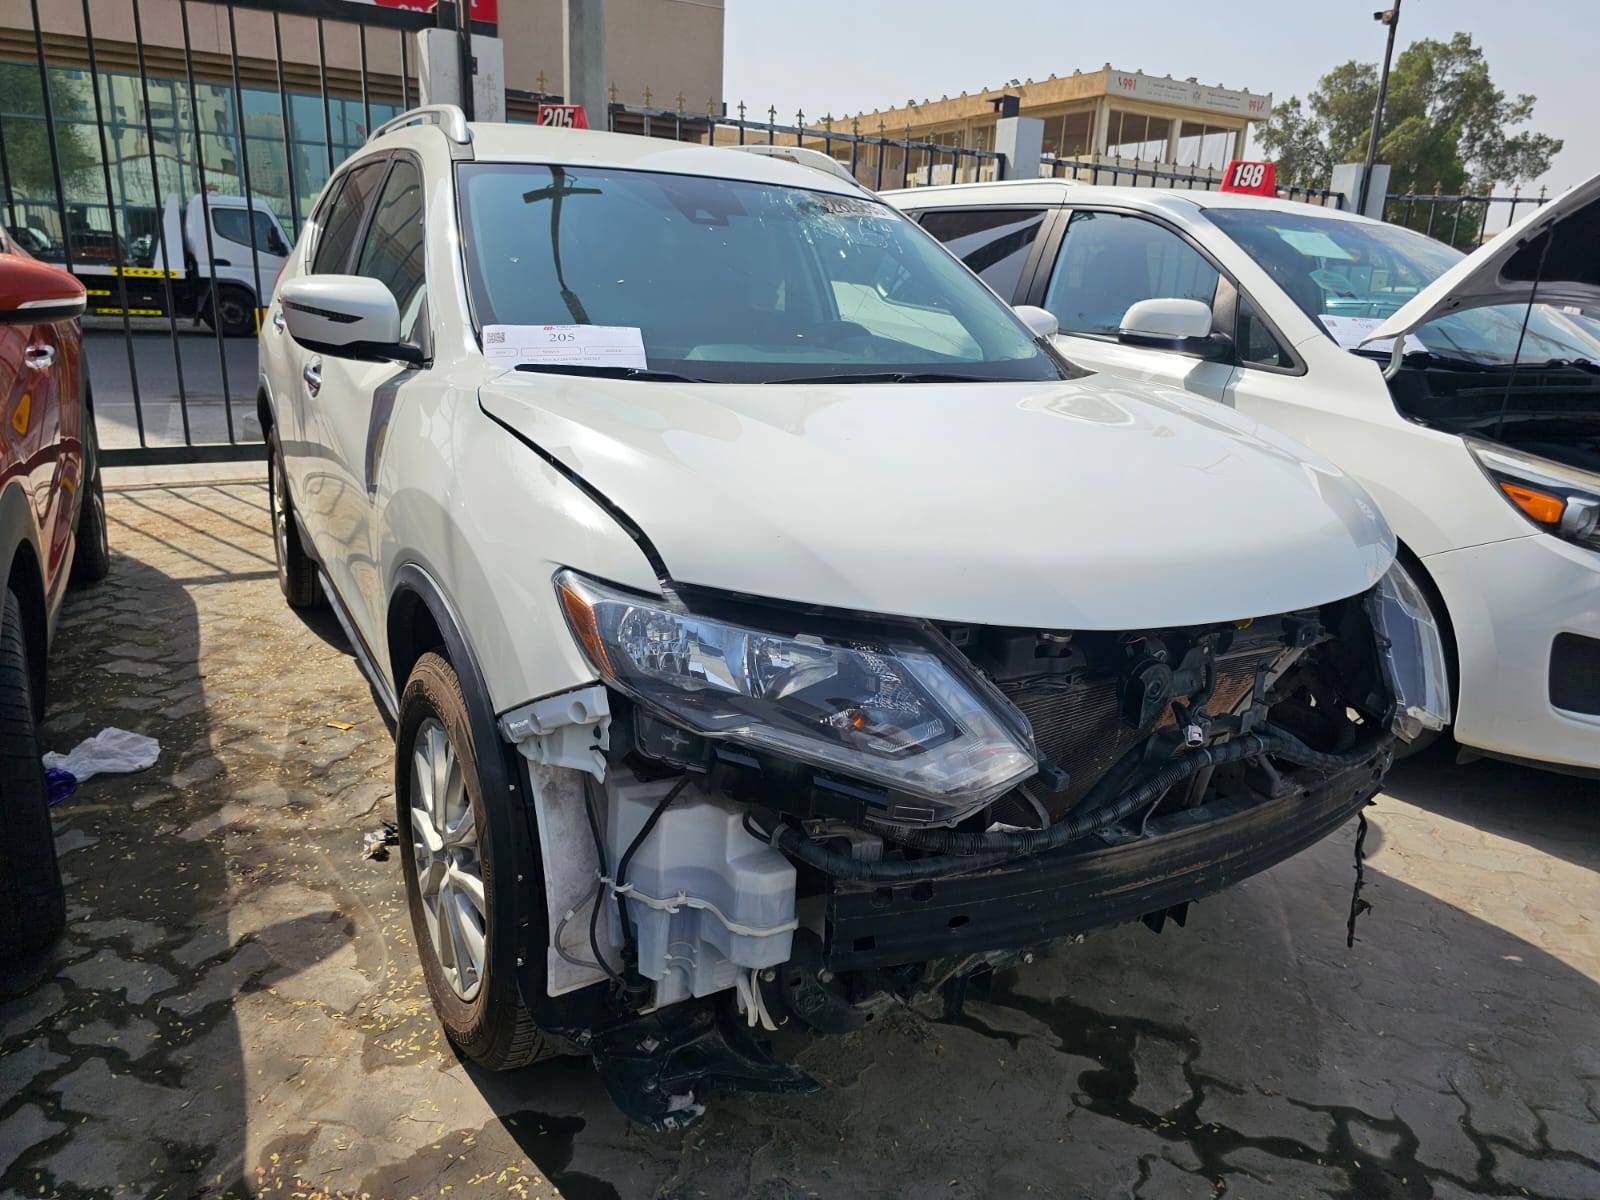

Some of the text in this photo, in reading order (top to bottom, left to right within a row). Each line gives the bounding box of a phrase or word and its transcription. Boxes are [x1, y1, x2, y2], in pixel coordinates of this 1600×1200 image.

[1123, 77, 1137, 91] 991
[543, 108, 574, 128] 205
[1233, 163, 1265, 188] 198
[549, 333, 575, 343] 205
